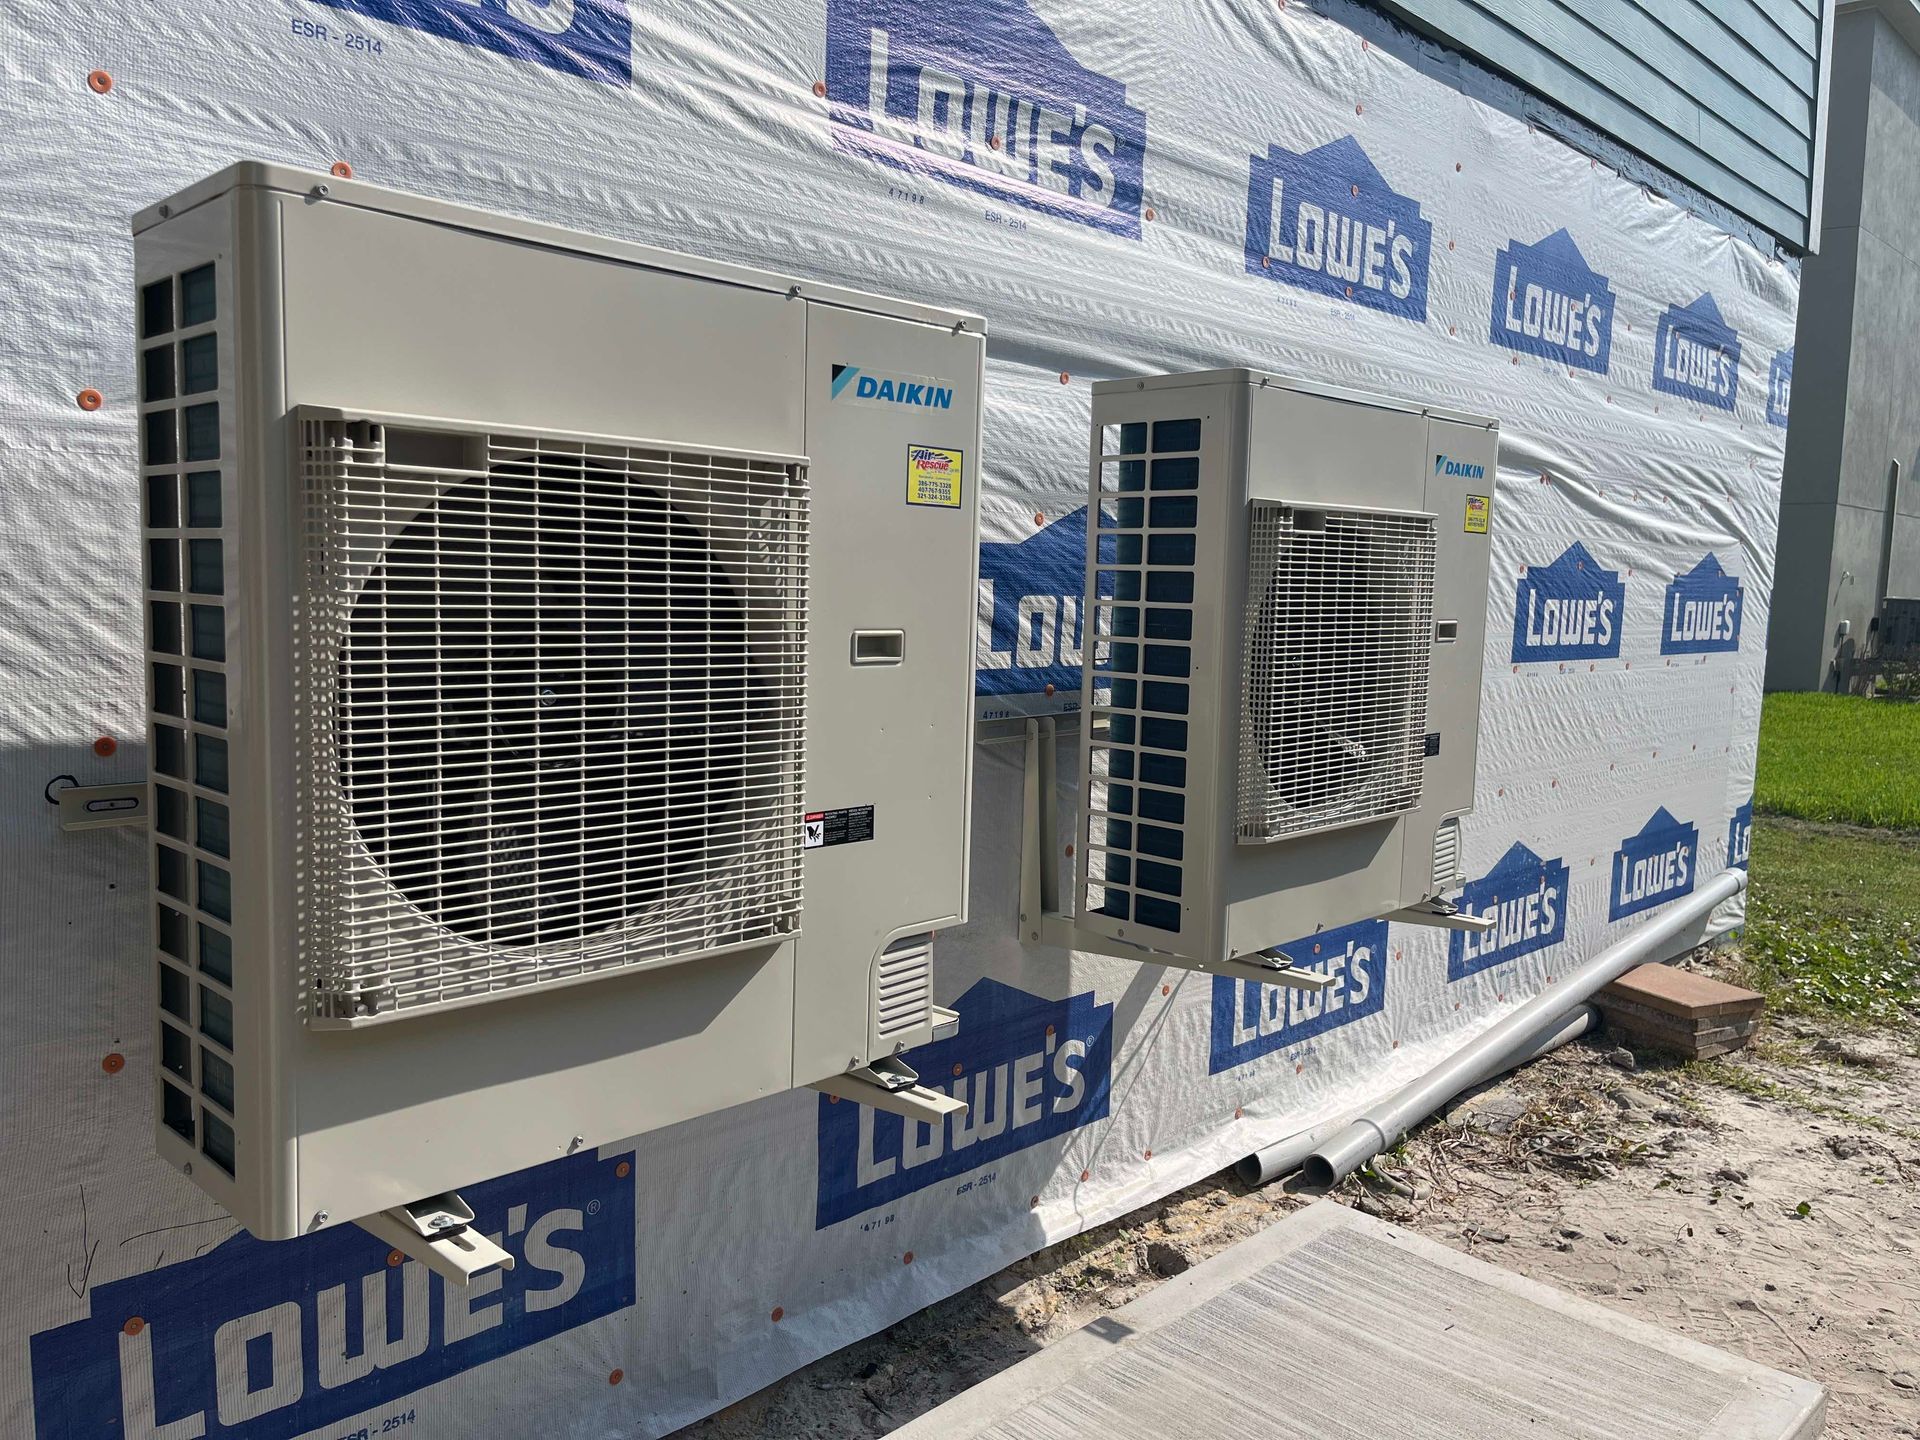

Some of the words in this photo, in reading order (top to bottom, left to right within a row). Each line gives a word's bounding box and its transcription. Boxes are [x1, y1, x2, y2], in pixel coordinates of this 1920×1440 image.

[291, 18, 327, 42] ESR
[344, 32, 383, 55] 2514
[869, 27, 1117, 208] LOWE'S
[1268, 177, 1413, 299] LOWE'S
[1505, 265, 1601, 357] LOWE'S
[857, 376, 952, 409] DAIKIN
[1663, 324, 1730, 397] LOWE'S
[916, 459, 949, 471] Rescue
[1445, 461, 1485, 479] DAIKIN
[977, 578, 1113, 669] LOW
[1526, 588, 1614, 646] LOWE'S
[1671, 592, 1735, 642] LOWE'S
[1620, 841, 1689, 906] LOWE'S
[1463, 881, 1557, 962] LOWE'S
[1233, 941, 1371, 1047] LOWE'S
[857, 1032, 1085, 1189] LOWE'S
[118, 1202, 585, 1440] LOWE'S
[382, 1409, 416, 1433] 2514
